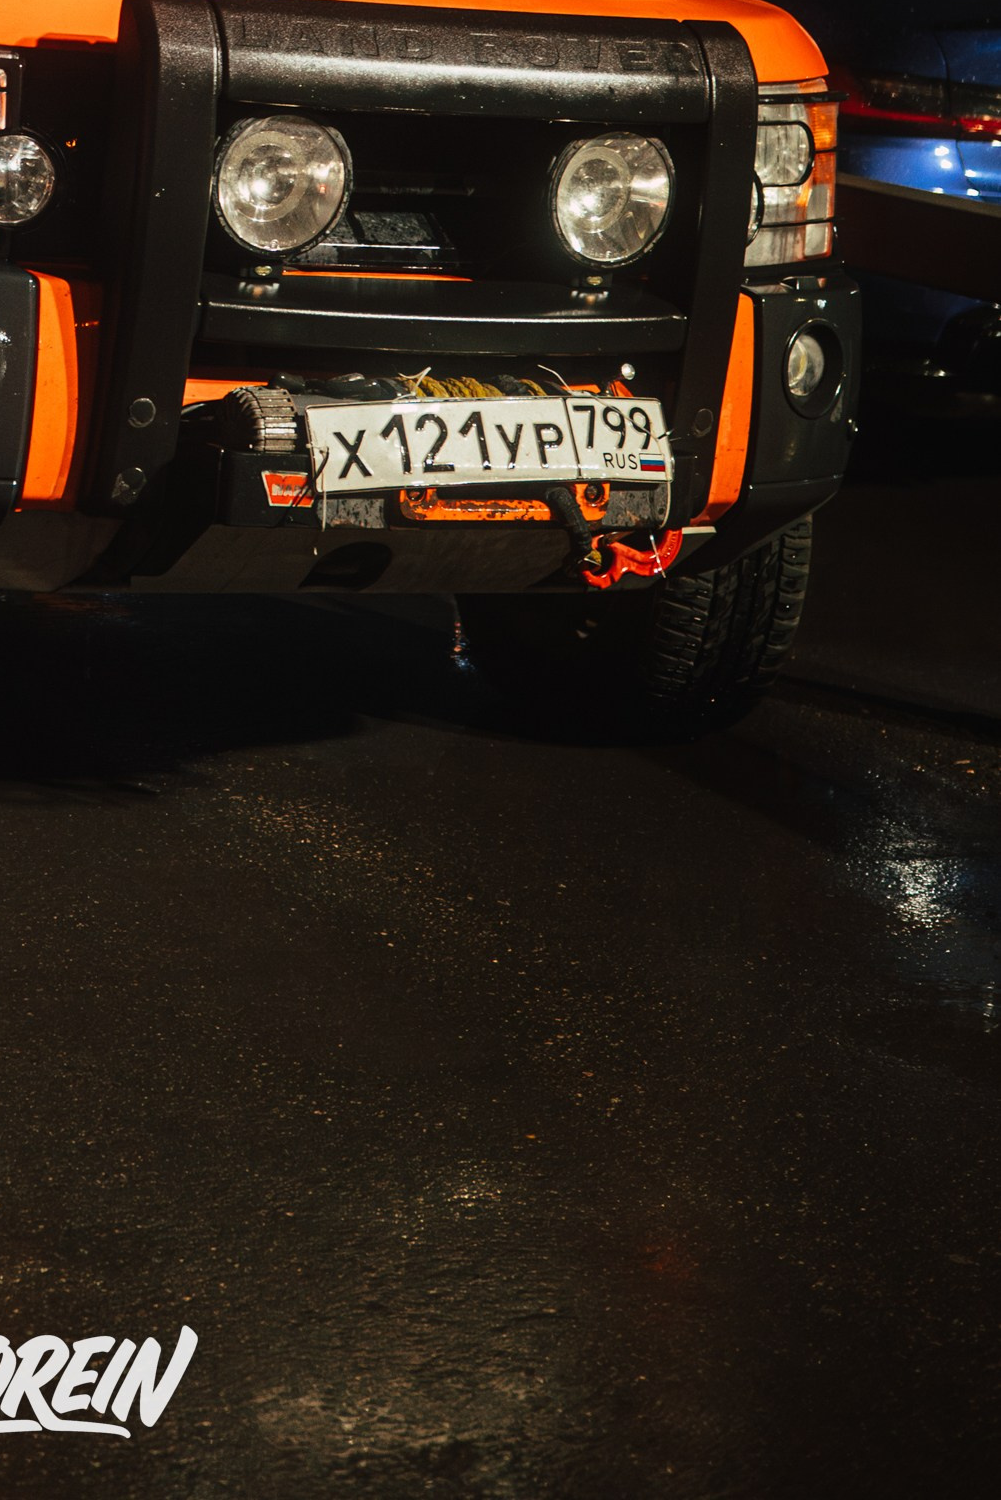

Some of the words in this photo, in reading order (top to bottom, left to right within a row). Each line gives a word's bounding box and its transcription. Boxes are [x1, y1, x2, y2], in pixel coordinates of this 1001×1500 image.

[233, 14, 435, 60] LAND
[573, 404, 653, 451] 799
[603, 451, 639, 471] RUS
